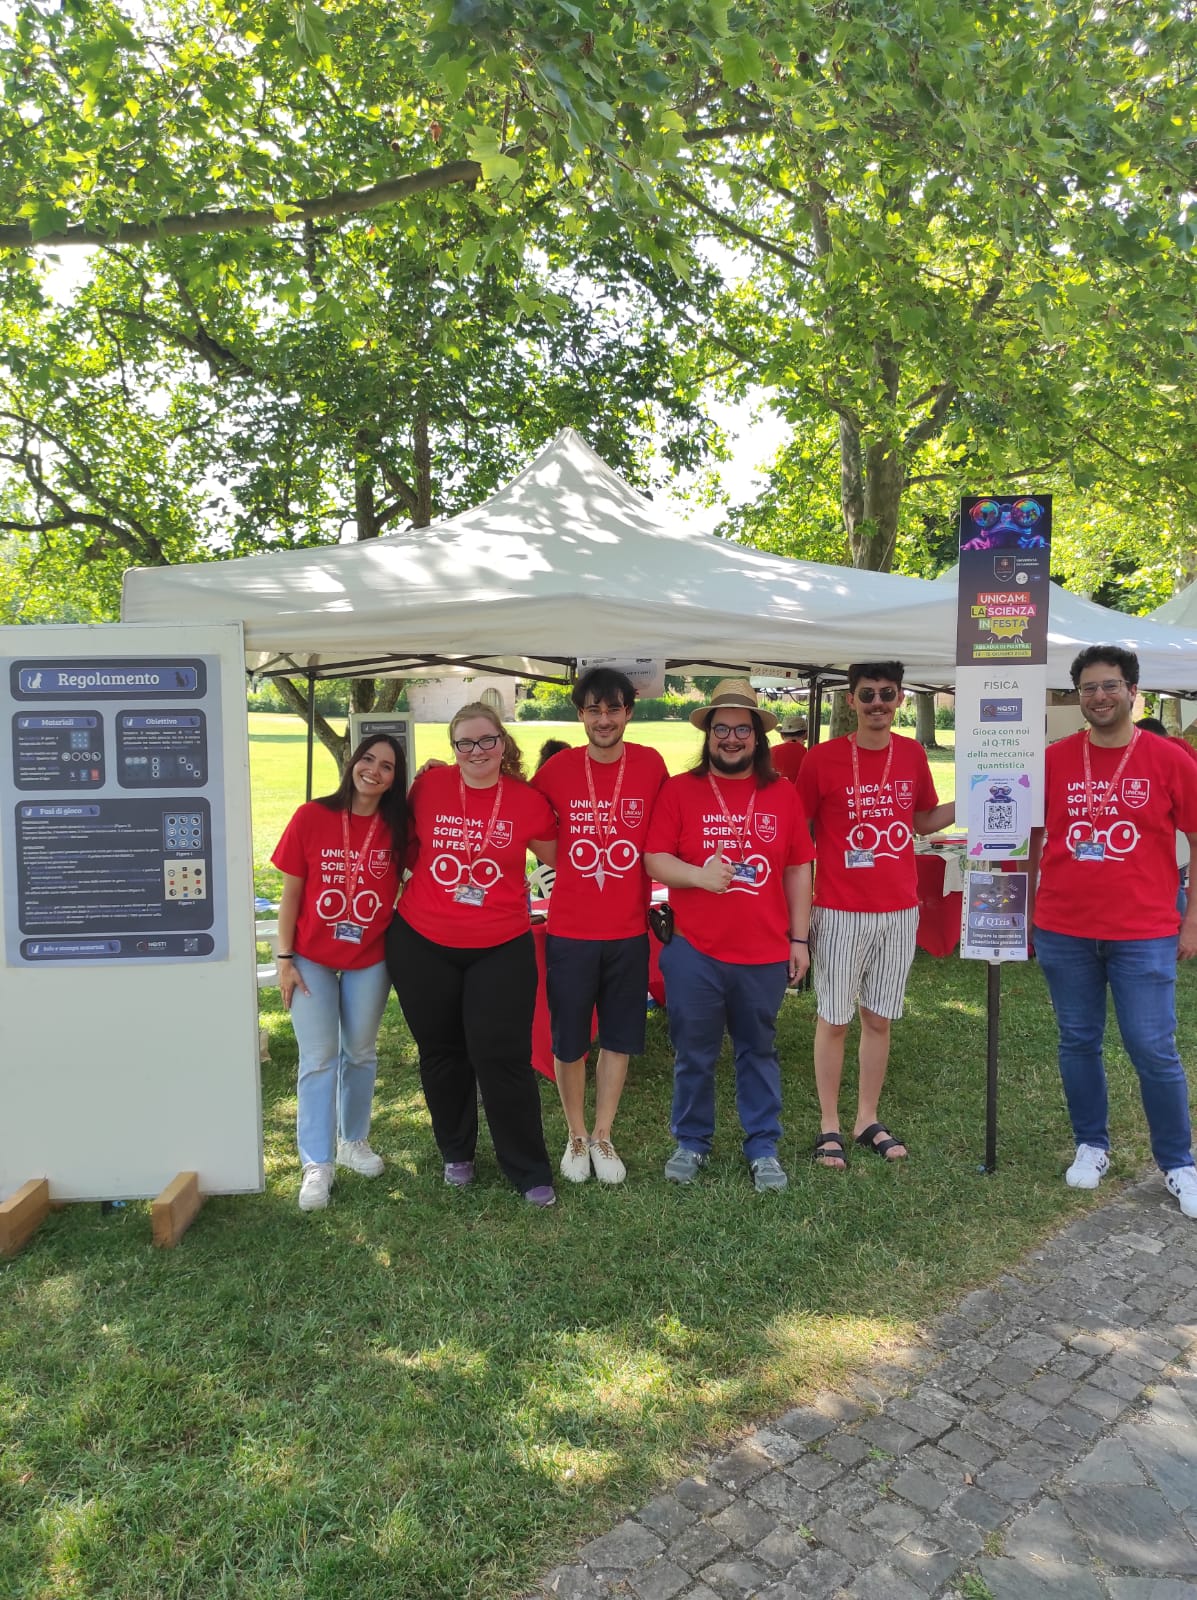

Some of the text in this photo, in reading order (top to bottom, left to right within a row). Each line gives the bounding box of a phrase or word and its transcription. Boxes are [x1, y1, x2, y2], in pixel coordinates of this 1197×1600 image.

[980, 594, 1027, 604] UNICAM:
[971, 606, 1035, 616] LA SCIENZA
[979, 619, 1026, 628] IN FESTA
[58, 672, 160, 688] Regolamento
[984, 681, 1019, 689] FISICA
[41, 718, 74, 726] Materiali
[145, 717, 177, 725] Obiettivo
[991, 739, 1020, 747] Q-TRIS
[977, 762, 1025, 770] quantistica
[1067, 781, 1118, 791] UNCAM:
[847, 795, 893, 808] SIENZA
[1067, 793, 1118, 804] SCINA
[570, 799, 613, 809] UNIAM
[64, 808, 83, 816] gioco
[1067, 806, 1118, 816] IN FTA
[435, 814, 484, 828] UNICAM:
[702, 814, 747, 823] UNICAM
[433, 826, 483, 840] SCIENZA
[570, 825, 617, 835] IN FETA
[432, 839, 481, 852] IN FESTA
[703, 840, 715, 848] IN
[321, 849, 361, 860] UNICAM
[320, 861, 365, 872] SCIEZA
[322, 873, 365, 885] IN FEA
[986, 917, 1010, 927] QTris
